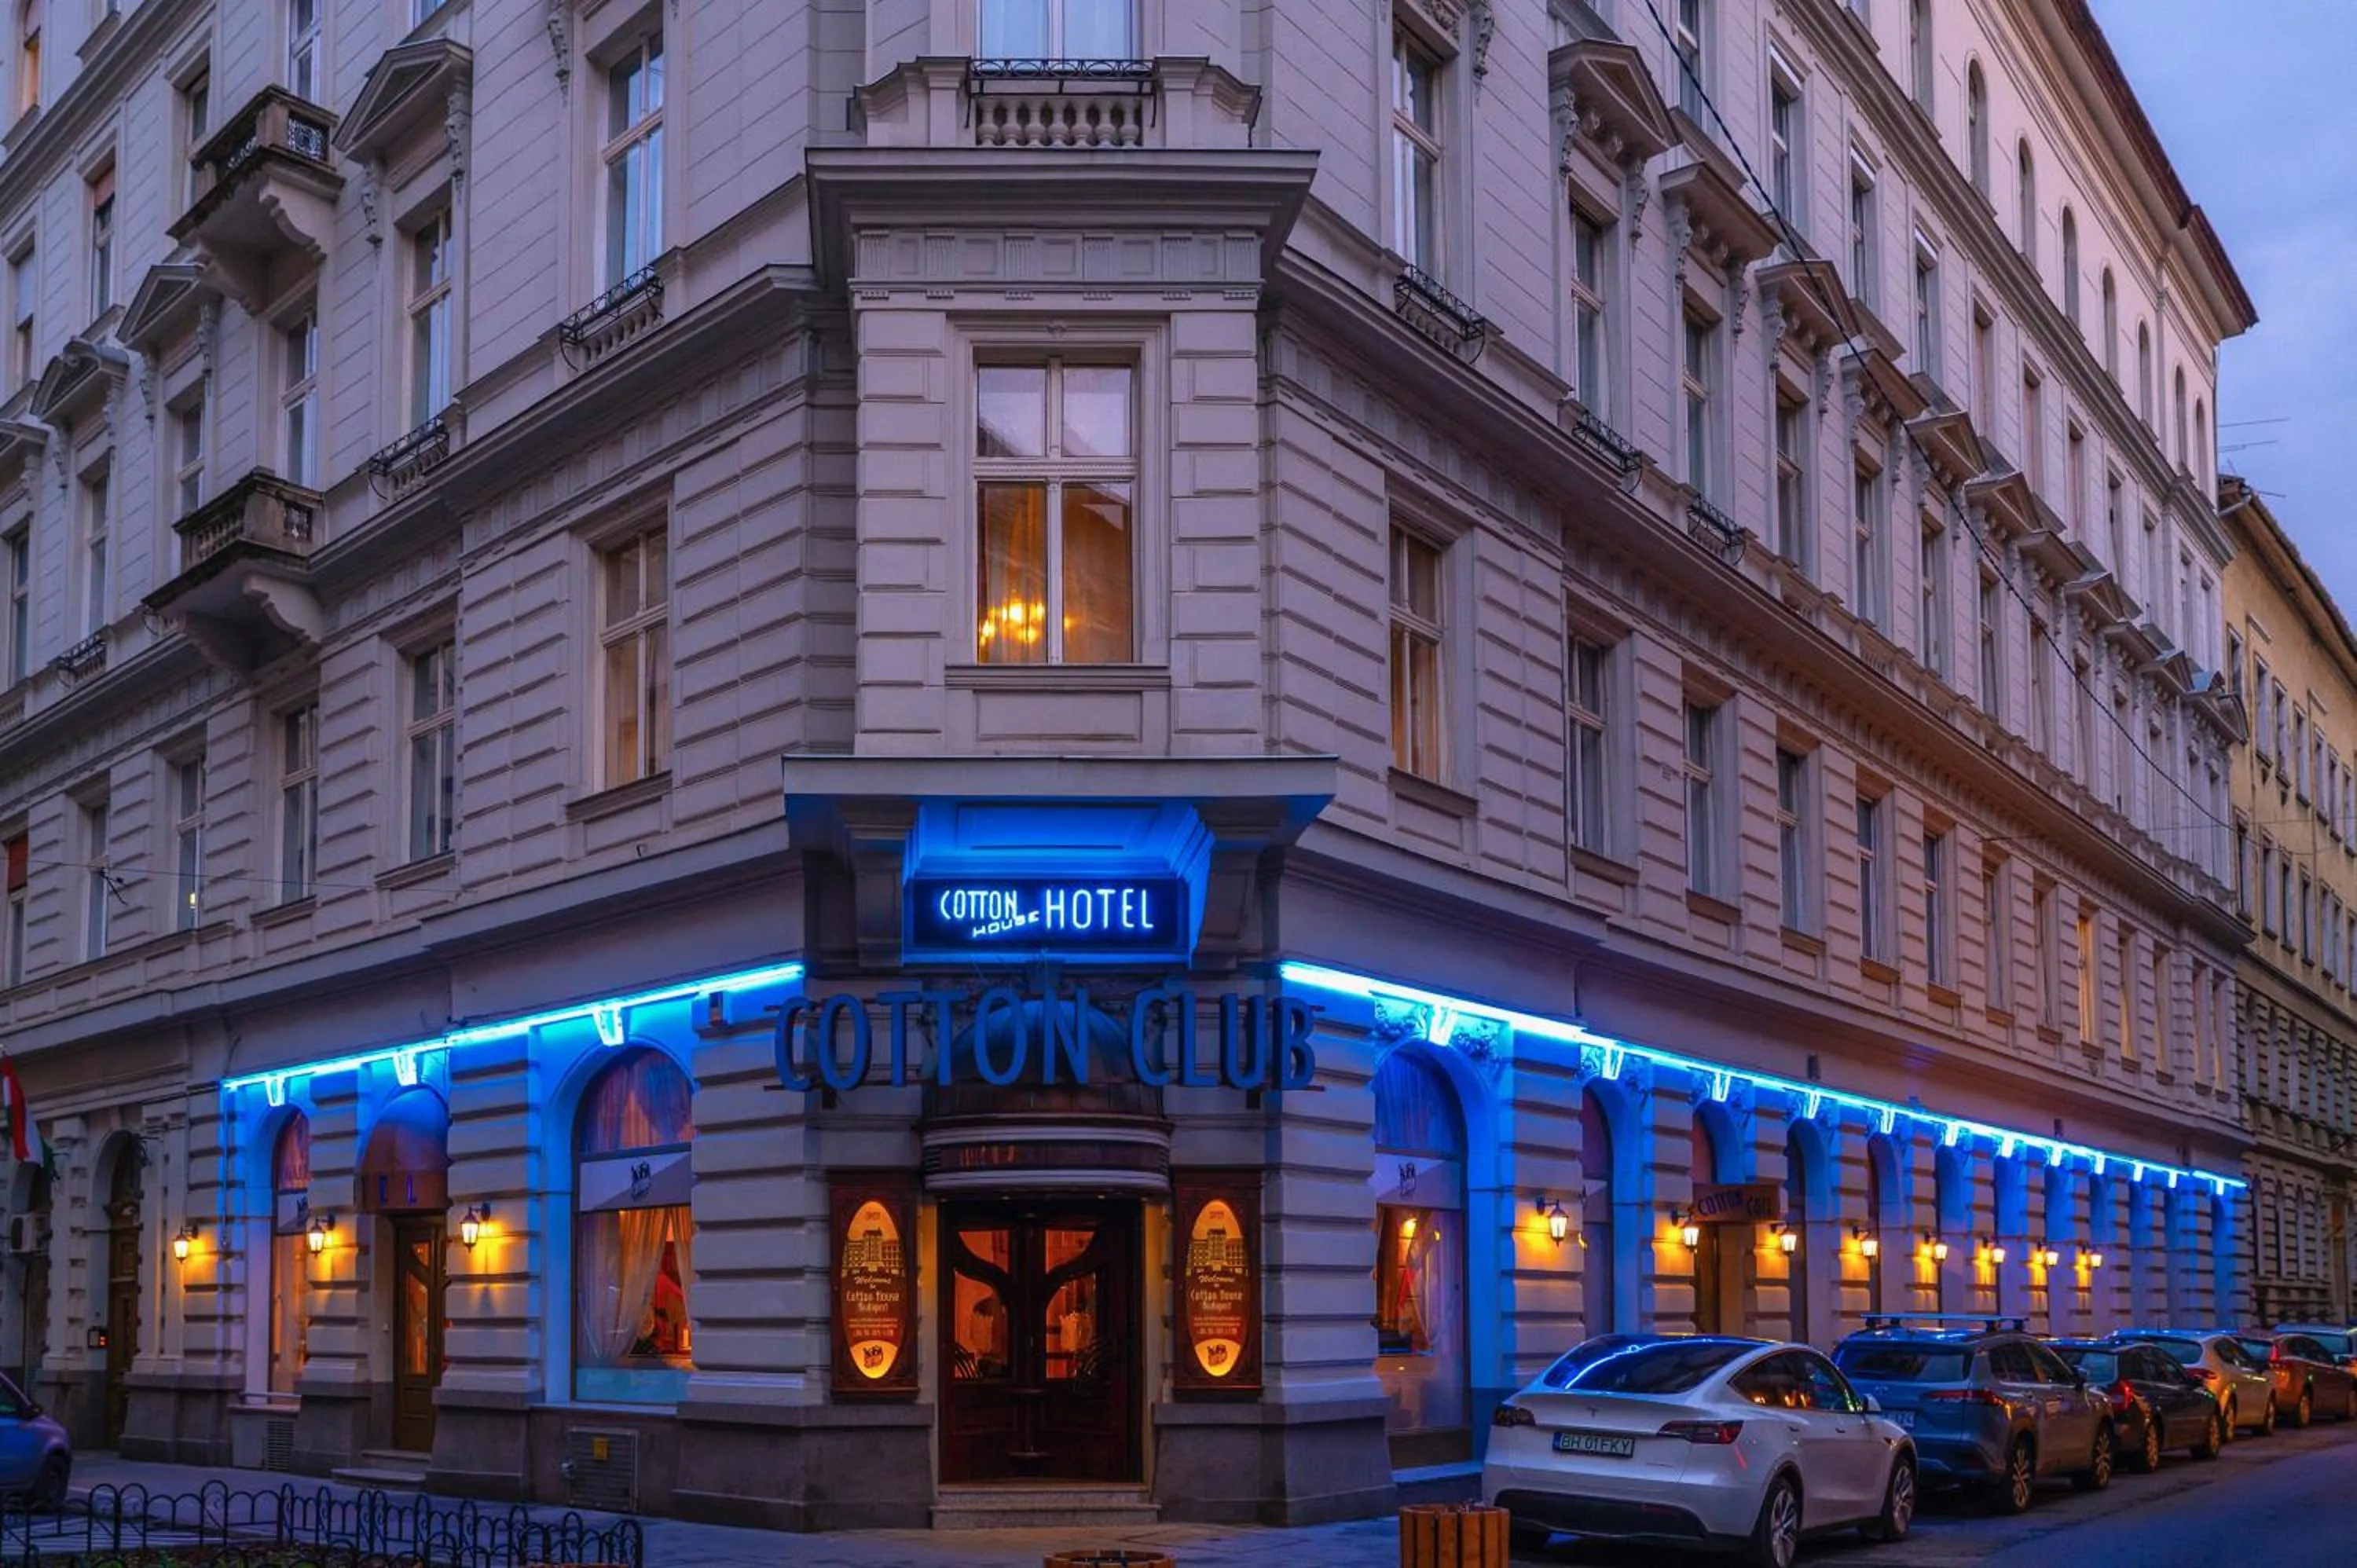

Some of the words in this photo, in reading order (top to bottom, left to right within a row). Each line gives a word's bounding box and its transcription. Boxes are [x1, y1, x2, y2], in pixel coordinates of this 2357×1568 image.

[940, 888, 1017, 921] COTTON
[1046, 888, 1154, 929] HOTEL
[971, 910, 1040, 938] HOUSE
[774, 987, 1090, 1091] COTTON
[1131, 987, 1317, 1091] CLUB
